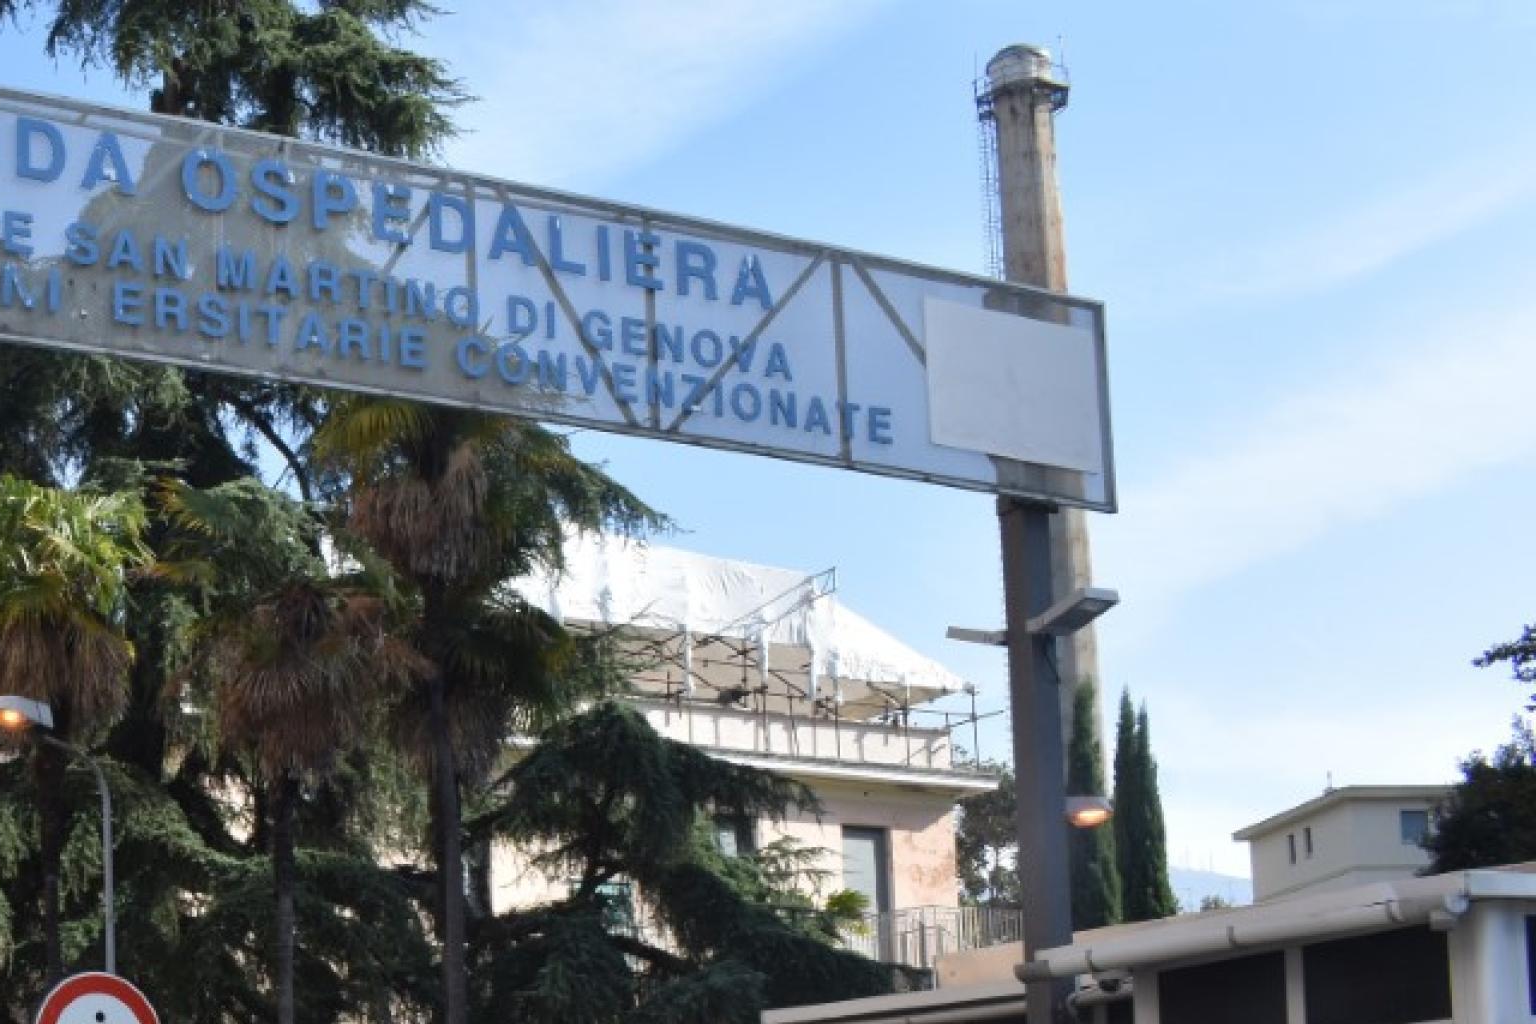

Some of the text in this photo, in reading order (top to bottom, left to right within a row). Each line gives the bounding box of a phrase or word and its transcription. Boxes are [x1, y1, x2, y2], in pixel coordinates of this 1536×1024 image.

[64, 218, 190, 282] SAN
[214, 246, 480, 330] MARTINO
[506, 293, 558, 341] DI
[584, 308, 794, 384] GENOVA
[180, 146, 777, 312] OSPEDALIERA
[454, 338, 895, 447] CONVENZIONATE
